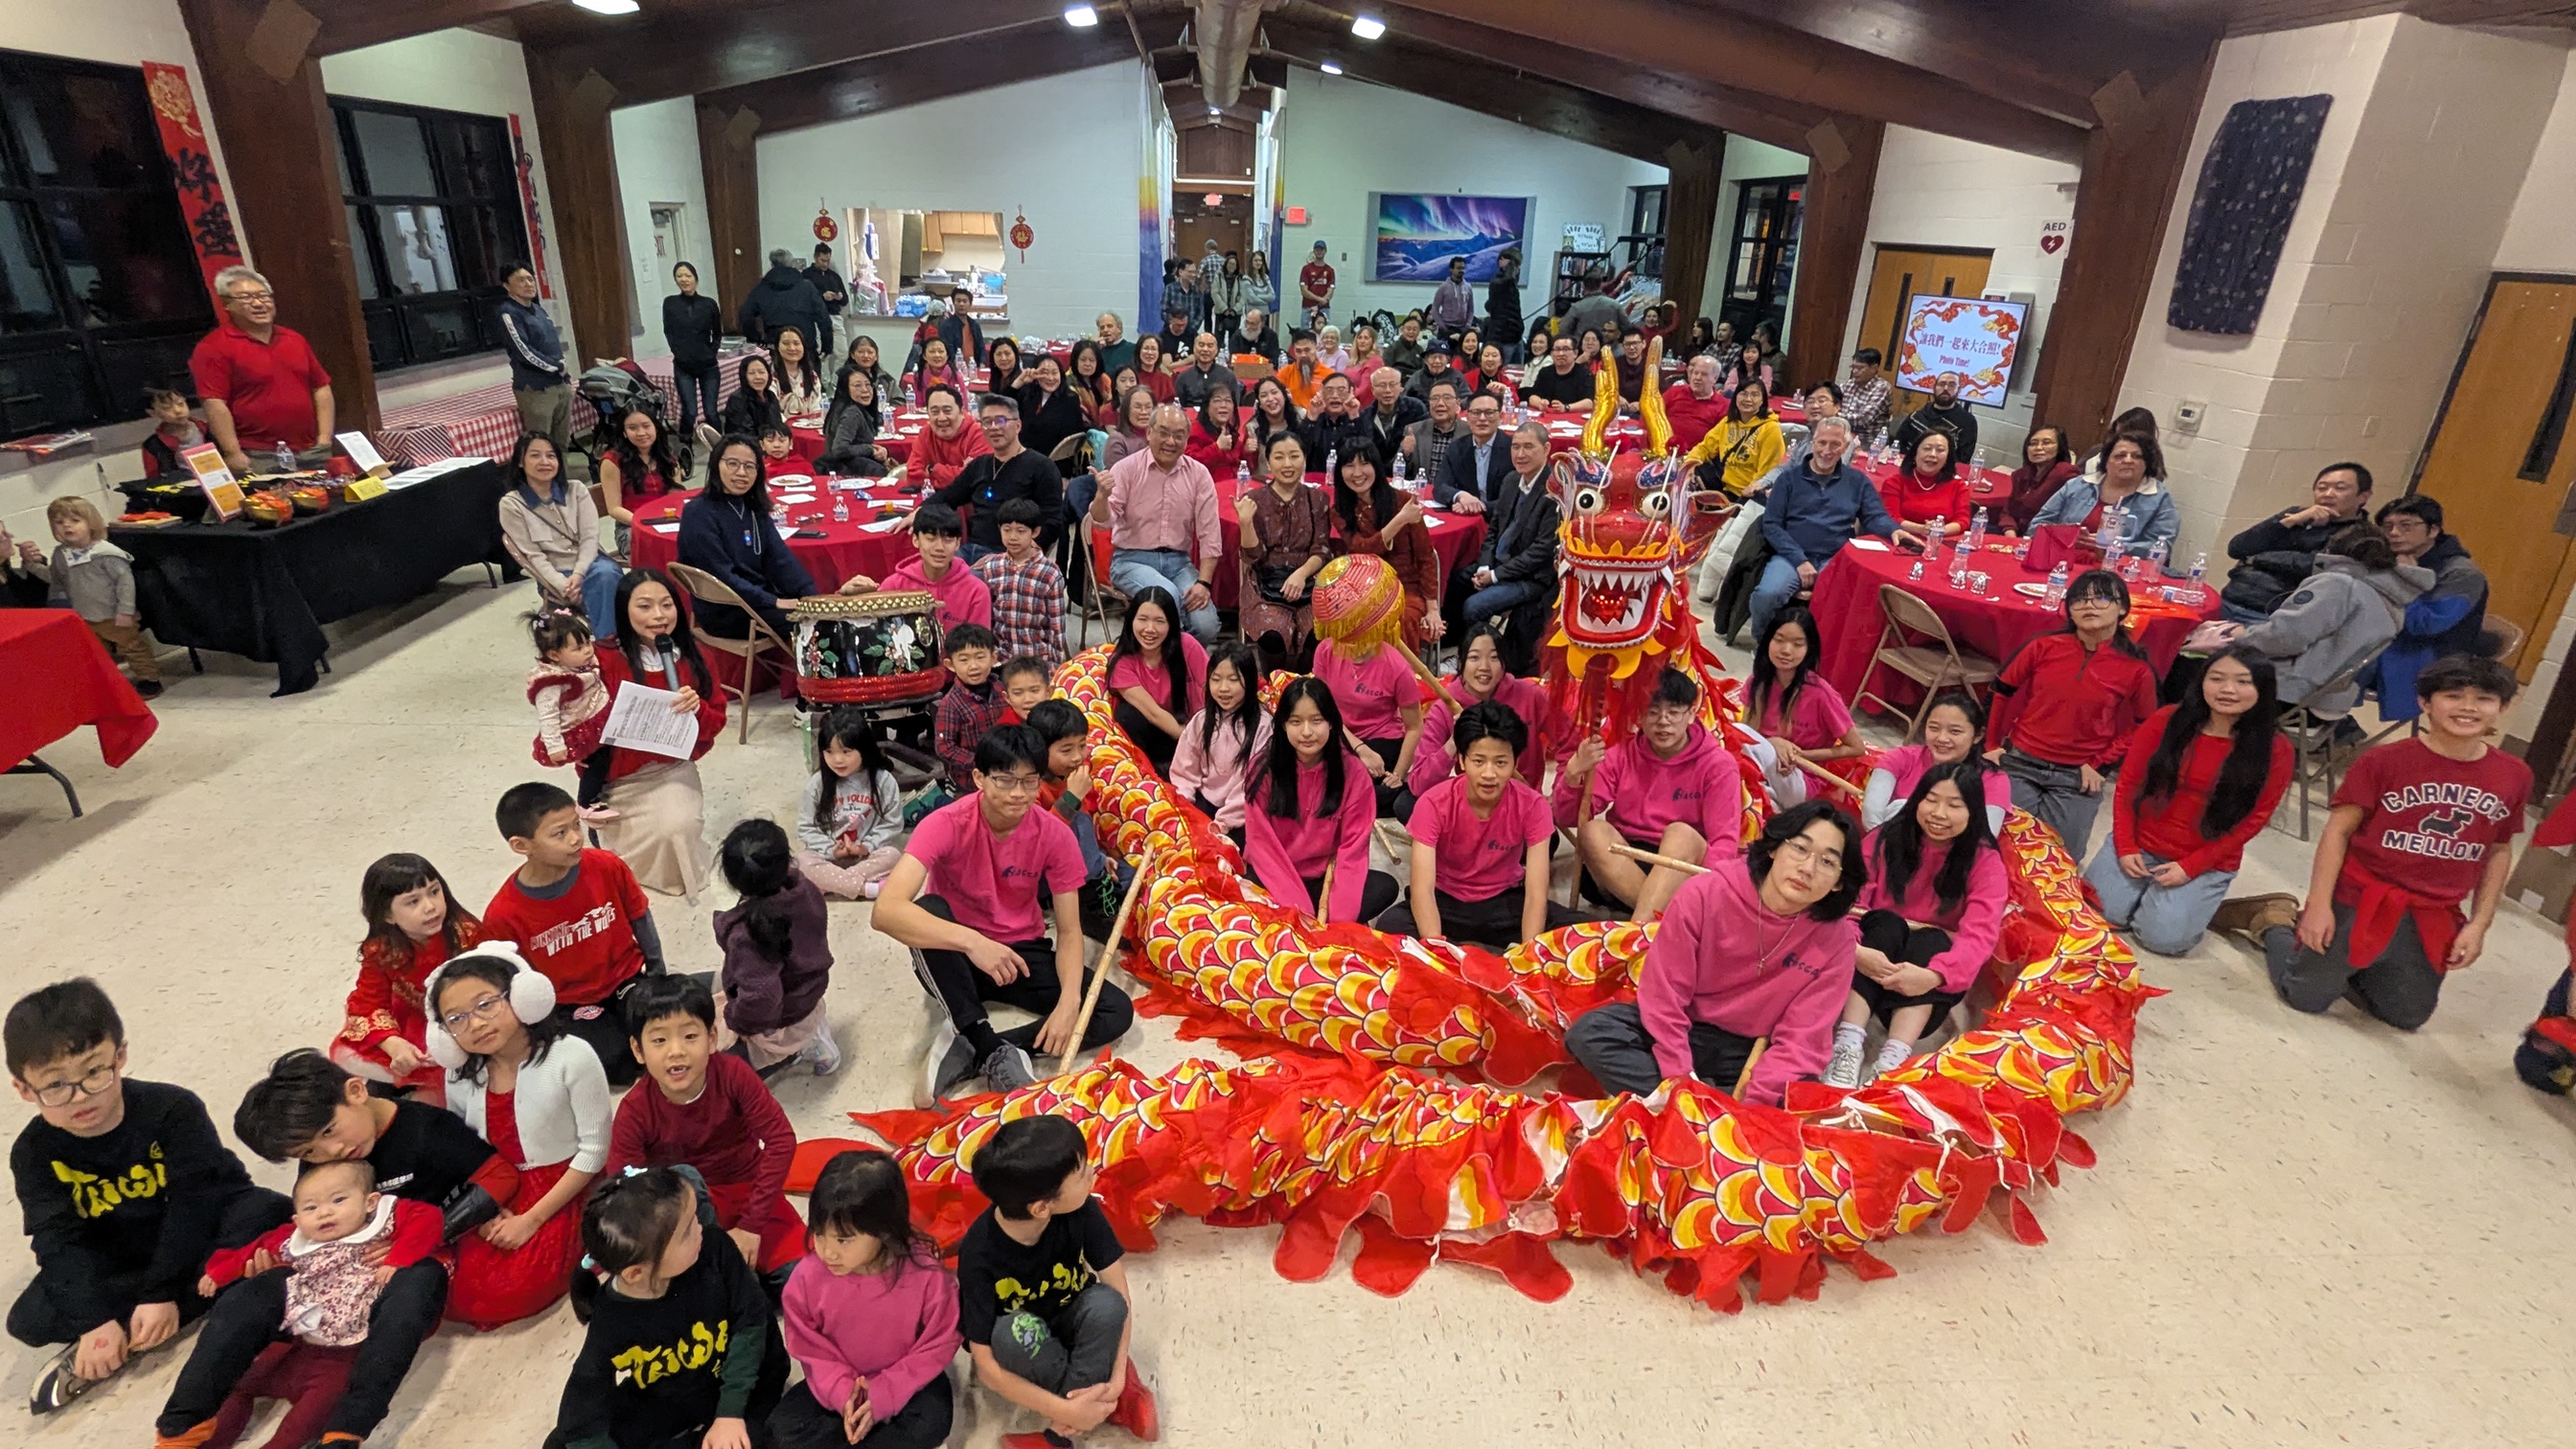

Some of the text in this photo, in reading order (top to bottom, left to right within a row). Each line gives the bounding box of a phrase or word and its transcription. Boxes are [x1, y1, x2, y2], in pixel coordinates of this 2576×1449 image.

[2043, 221, 2067, 231] AED
[1939, 355, 1954, 365] Photo
[2380, 782, 2510, 821] CARNEGE
[2381, 829, 2485, 862] MELLON
[546, 932, 573, 957] WITH
[576, 920, 593, 943] THE
